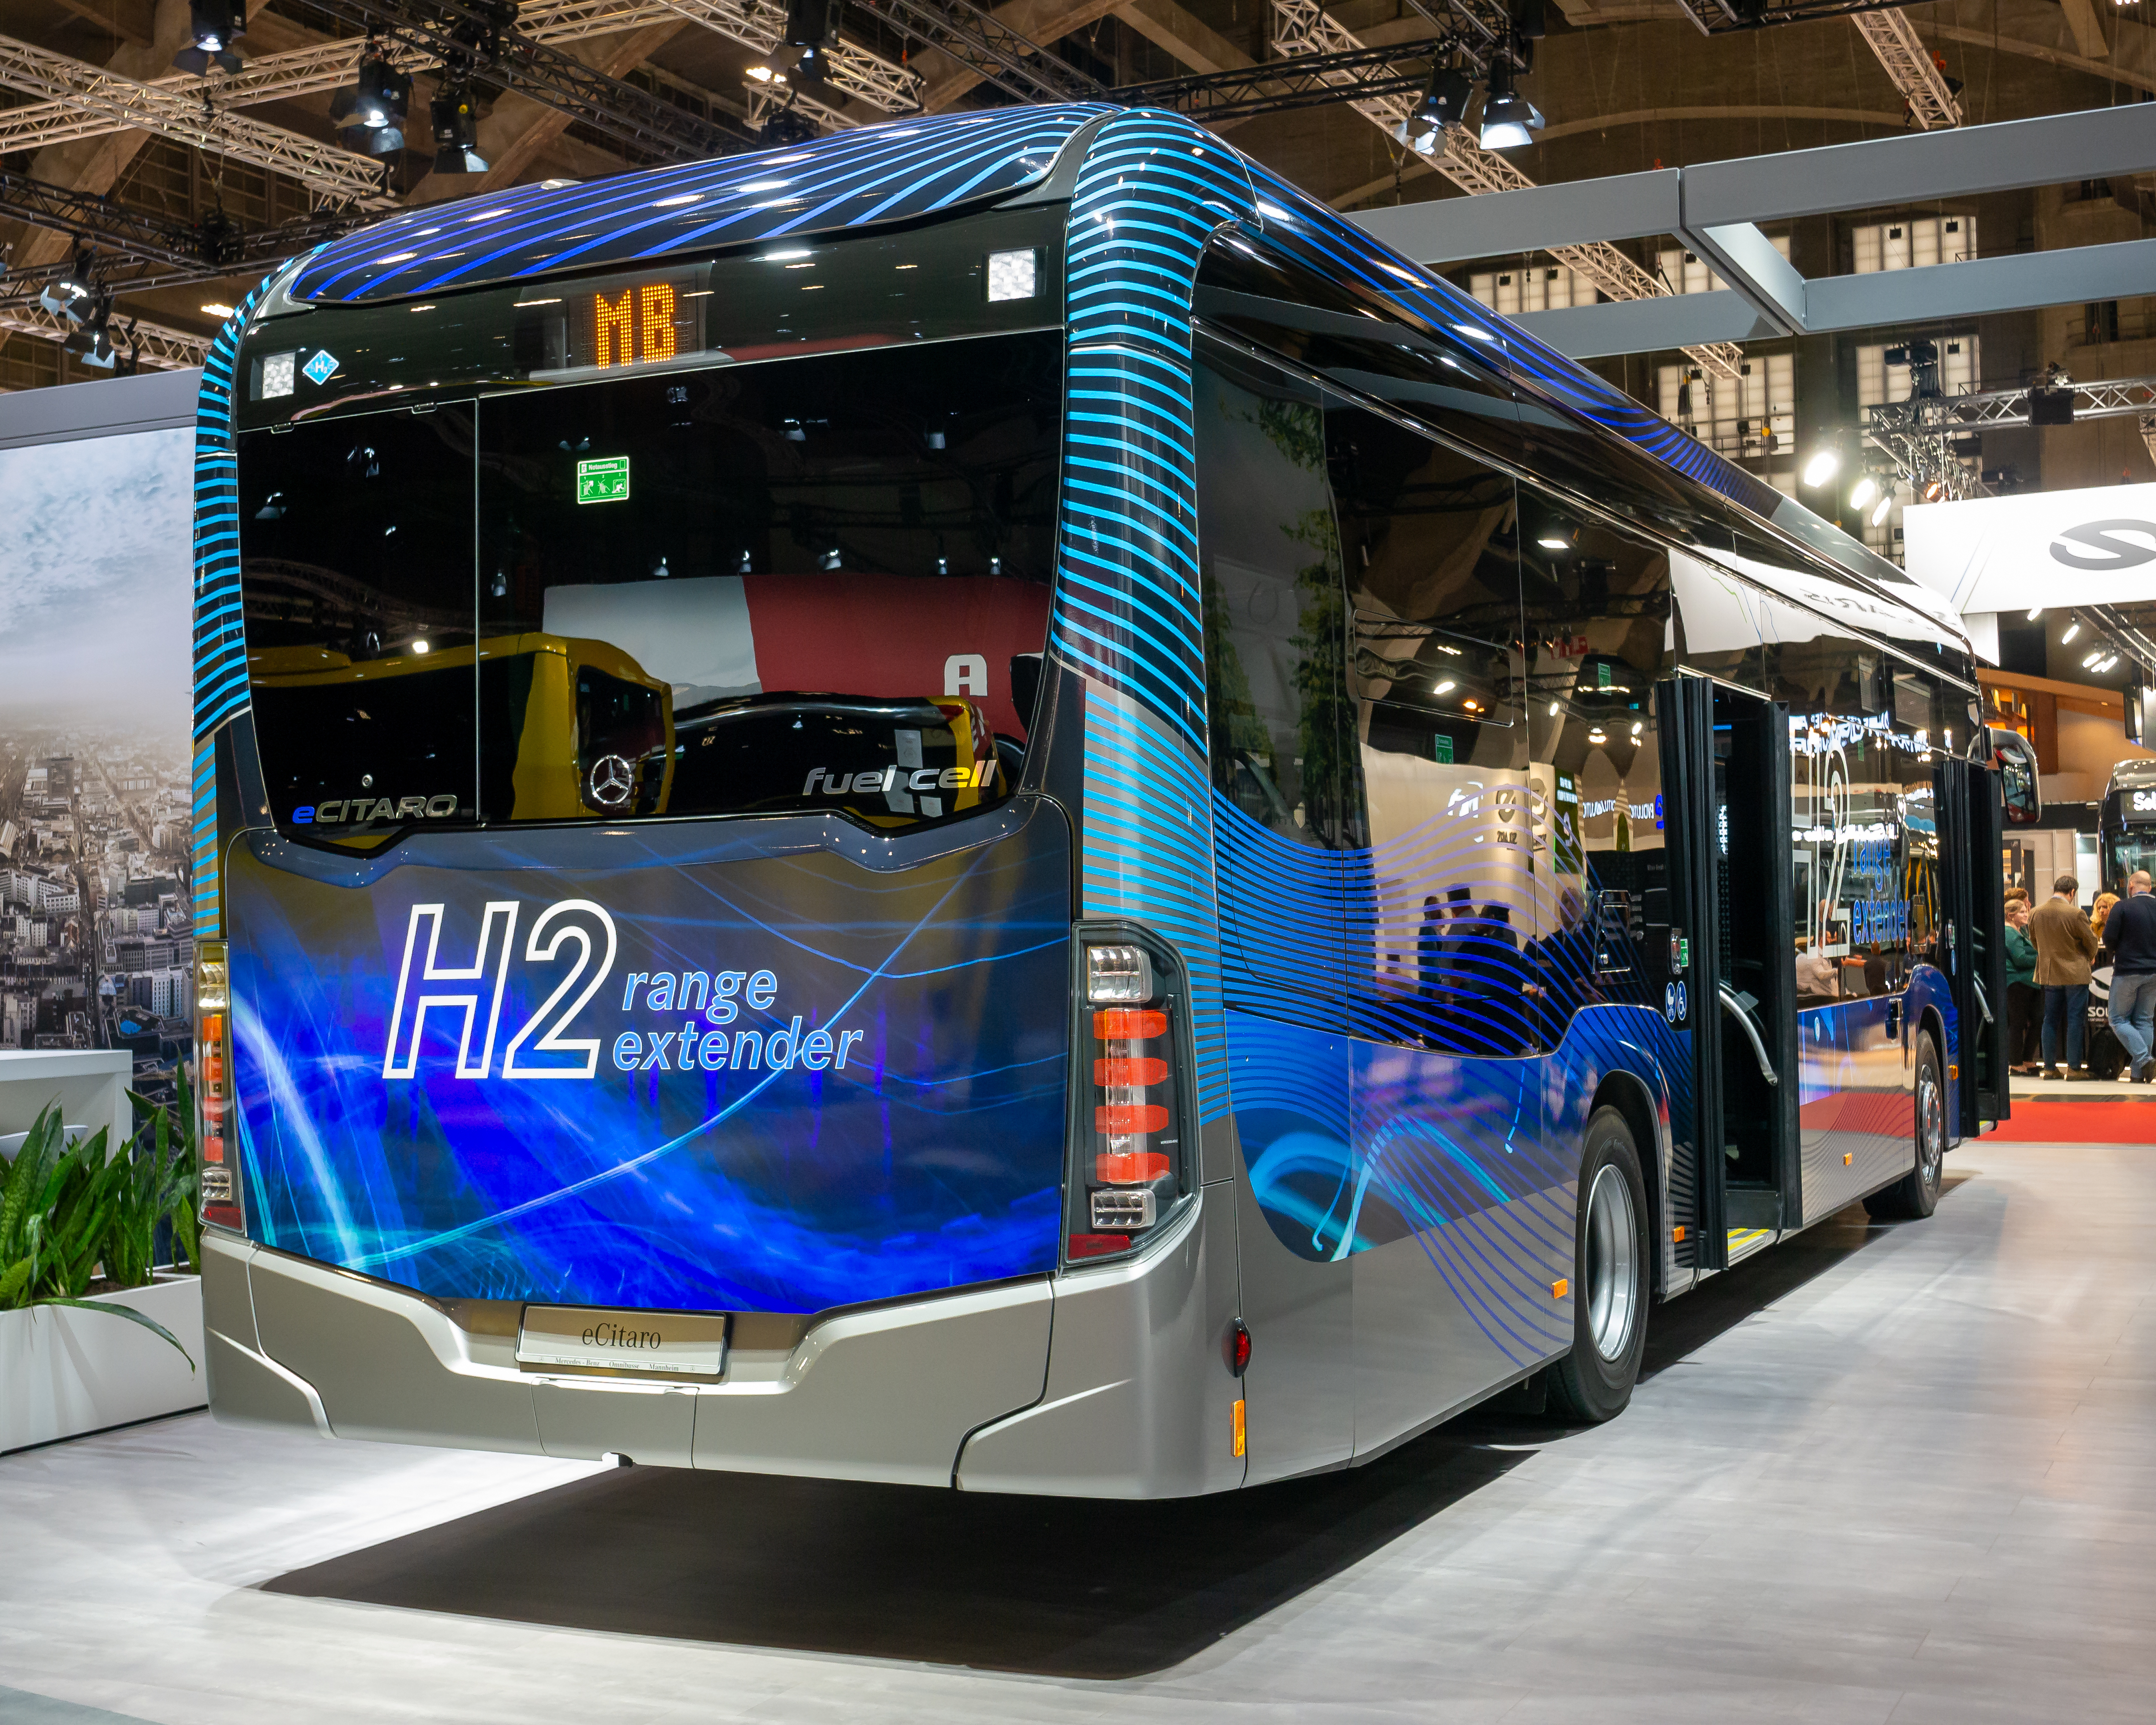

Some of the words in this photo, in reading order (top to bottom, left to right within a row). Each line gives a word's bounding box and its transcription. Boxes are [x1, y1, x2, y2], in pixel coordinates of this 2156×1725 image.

[596, 284, 675, 370] MB
[802, 765, 897, 796] fuel
[909, 759, 993, 790] cell
[292, 795, 458, 824] eCITARO
[1853, 835, 1891, 892] range
[1853, 883, 1910, 945] extender
[382, 899, 617, 1079] H2
[622, 969, 778, 1025] range
[613, 1016, 863, 1071] extender
[582, 1323, 661, 1349] eCitaro
